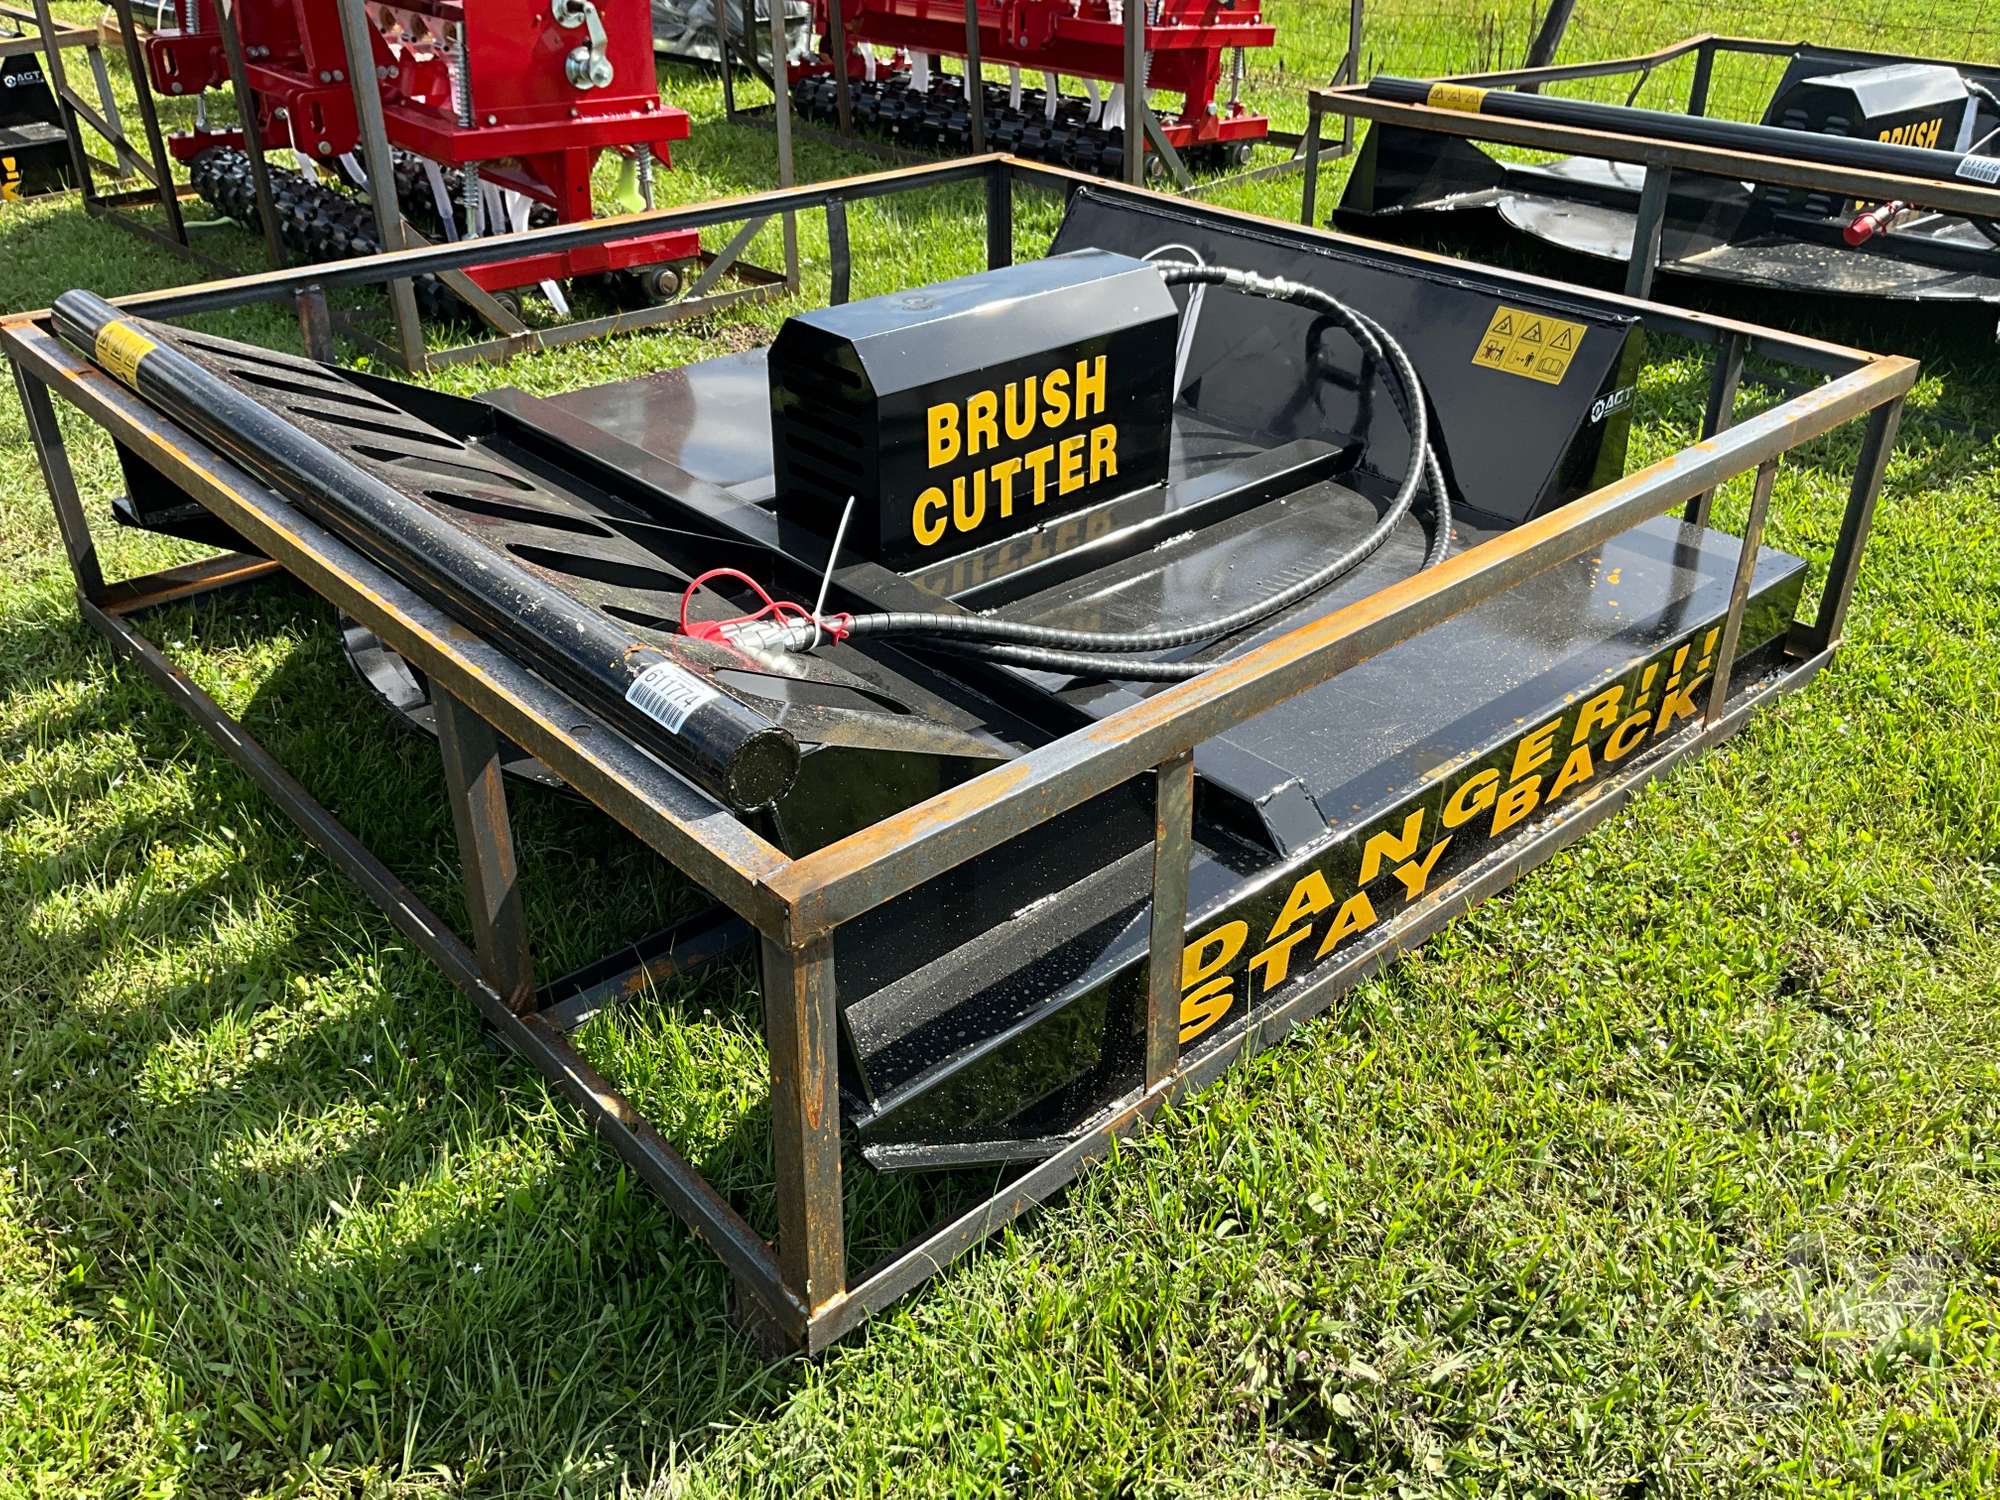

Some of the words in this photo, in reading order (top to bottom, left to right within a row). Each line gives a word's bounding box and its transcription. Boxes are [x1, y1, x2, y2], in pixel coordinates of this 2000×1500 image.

[927, 354, 1107, 469] BRUSH
[1605, 385, 1634, 409] AGT
[912, 423, 1118, 546] CUTTER
[644, 669, 701, 708] 611774
[1179, 835, 1453, 1045] STAY
[1489, 672, 1709, 838] BACK
[1181, 626, 1721, 992] DANGER!!!
